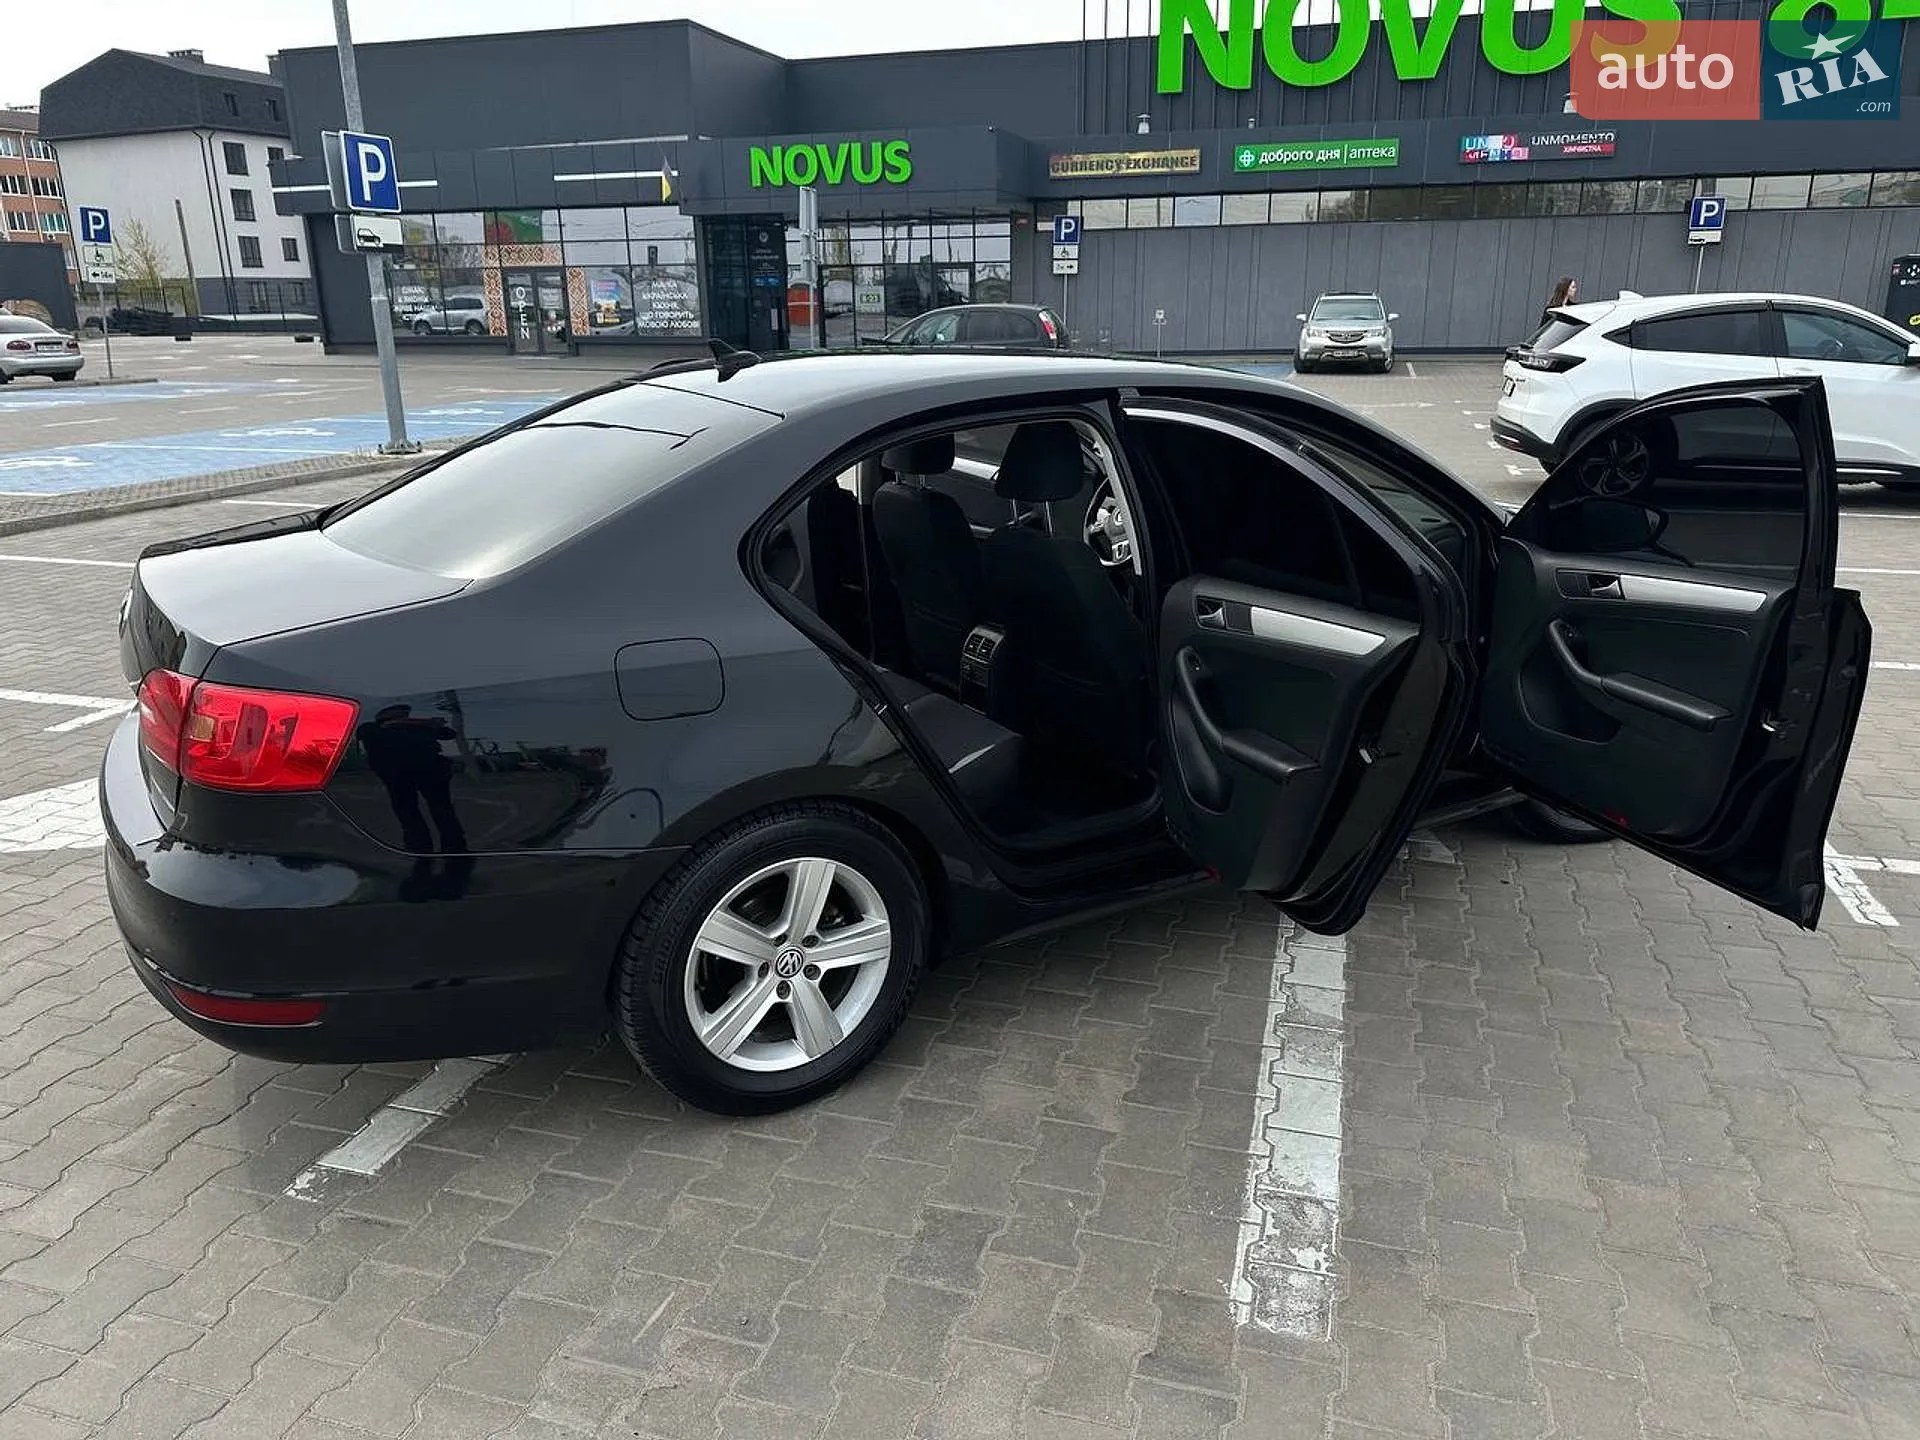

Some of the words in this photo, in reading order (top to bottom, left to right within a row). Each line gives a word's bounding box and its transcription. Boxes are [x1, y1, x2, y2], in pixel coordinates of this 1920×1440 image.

[1156, 0, 1682, 94] NOVUS
[750, 140, 912, 187] NOVUS
[1051, 158, 1124, 174] CURRENCY
[1126, 155, 1198, 170] EXCHANGE
[1259, 149, 1313, 164] доброго
[1316, 149, 1341, 163] дня
[1349, 147, 1396, 159] аптека
[357, 142, 387, 201] P
[88, 210, 105, 239] P
[1699, 200, 1719, 226] P
[1060, 218, 1075, 240] P
[515, 286, 531, 340] OPEN
